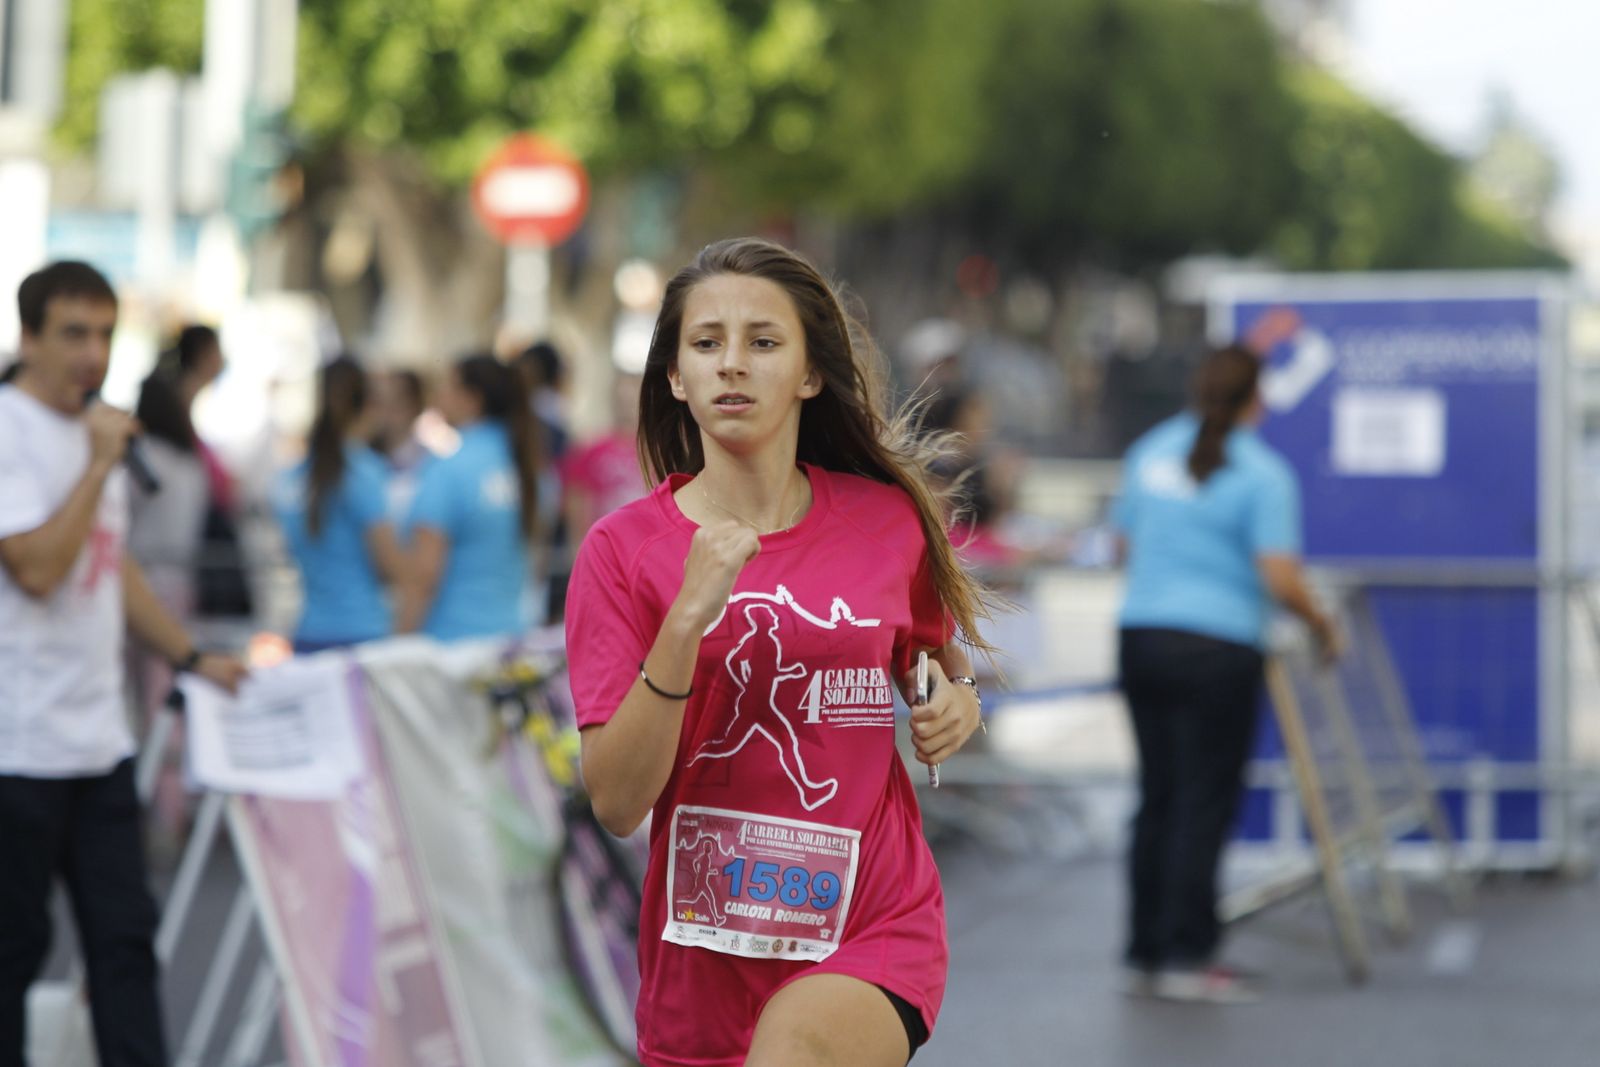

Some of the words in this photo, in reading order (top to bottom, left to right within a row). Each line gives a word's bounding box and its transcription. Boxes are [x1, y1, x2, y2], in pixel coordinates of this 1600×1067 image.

[797, 669, 826, 724] 4
[736, 820, 748, 846] 4
[747, 822, 795, 843] CARRERA
[797, 831, 849, 851] SOLIDARIA
[756, 838, 767, 846] LAS
[722, 857, 842, 911] 1589
[677, 911, 686, 920] La
[694, 913, 710, 923] Salle
[724, 901, 772, 920] CARLOTA
[773, 908, 827, 927] ROMERO
